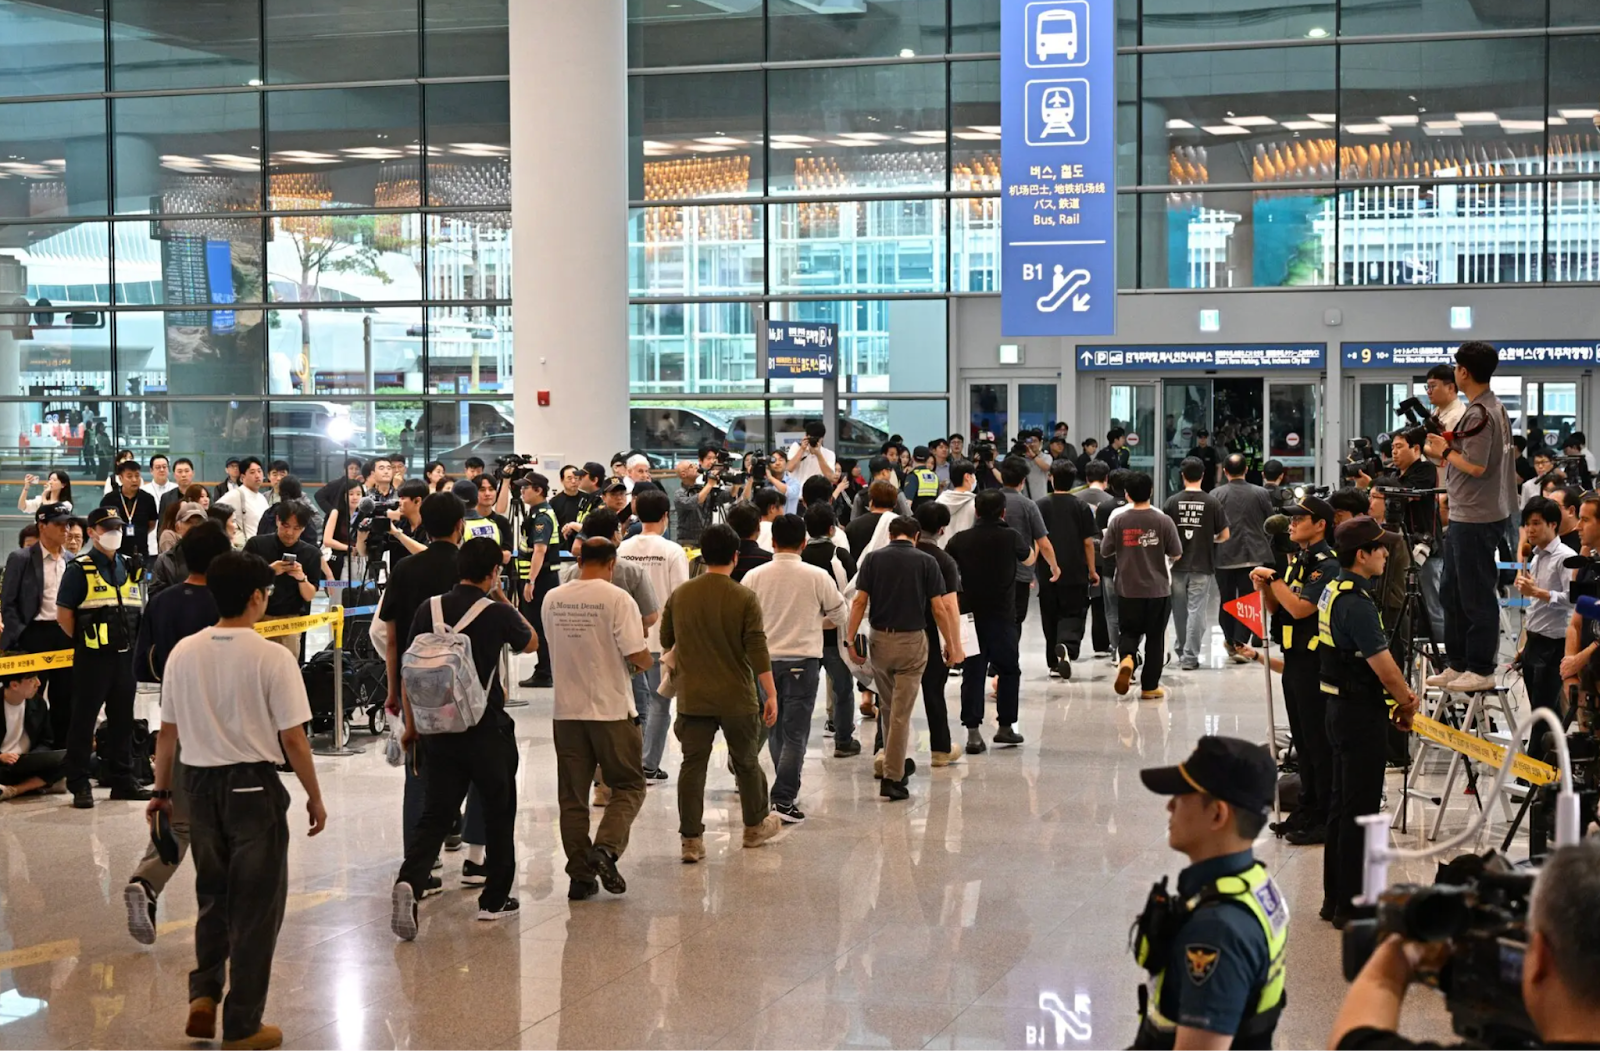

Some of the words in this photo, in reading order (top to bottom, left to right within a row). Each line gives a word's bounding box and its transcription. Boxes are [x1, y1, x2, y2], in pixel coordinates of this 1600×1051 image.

[1030, 165, 1057, 180] 버스,
[1061, 164, 1084, 179] 철도
[1009, 184, 1052, 196] 机场巴士,
[1054, 182, 1105, 194] 地铁机场线
[1034, 199, 1056, 210] バス,
[1059, 198, 1080, 209] 鉄道
[1033, 215, 1055, 226] Bus,
[1059, 213, 1080, 224] Rail
[1023, 263, 1042, 280] B1
[1361, 348, 1371, 363] 9
[556, 601, 579, 610] Mount
[264, 625, 280, 633] SECURITY
